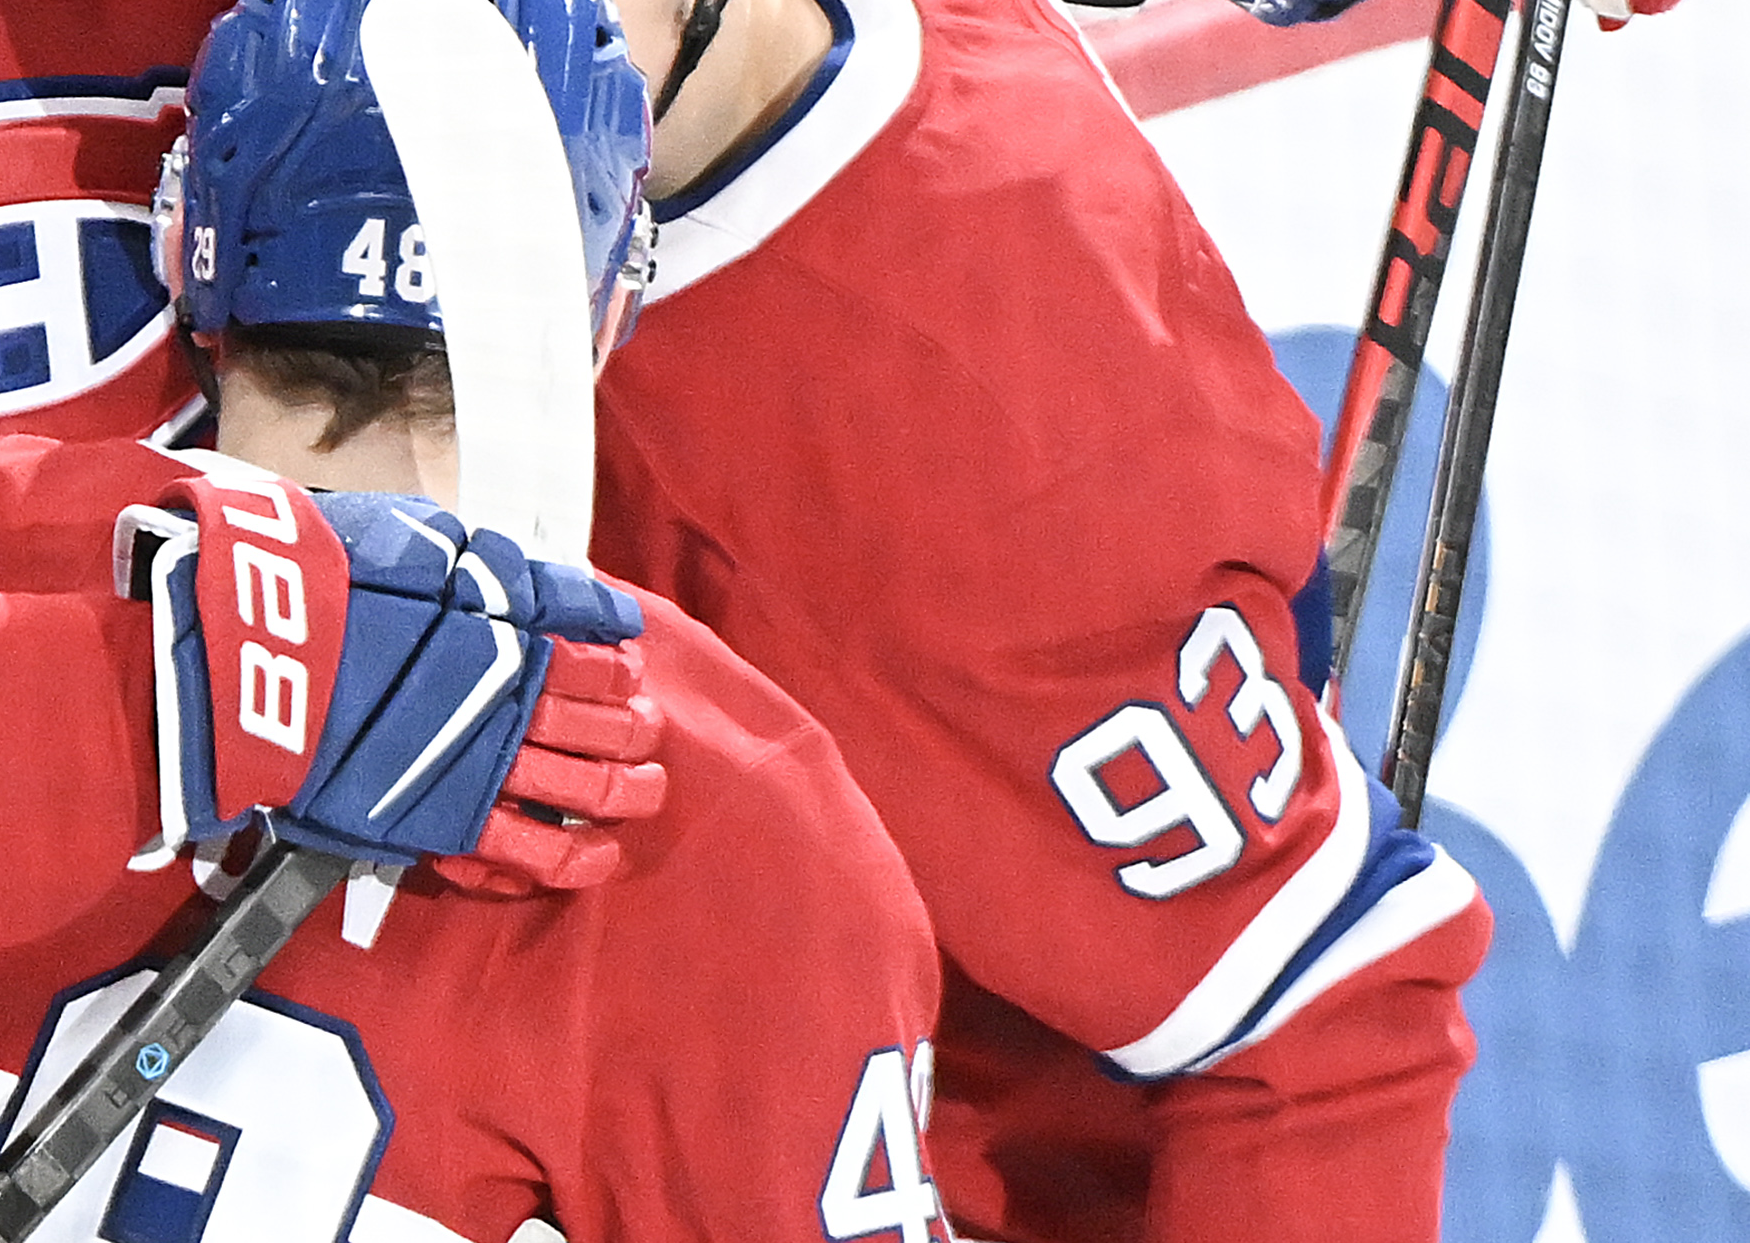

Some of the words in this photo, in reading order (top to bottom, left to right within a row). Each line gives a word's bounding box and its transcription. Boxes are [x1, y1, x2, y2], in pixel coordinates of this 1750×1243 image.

[341, 217, 439, 304] 48
[1050, 603, 1303, 899] 93
[820, 1040, 942, 1243] 4
